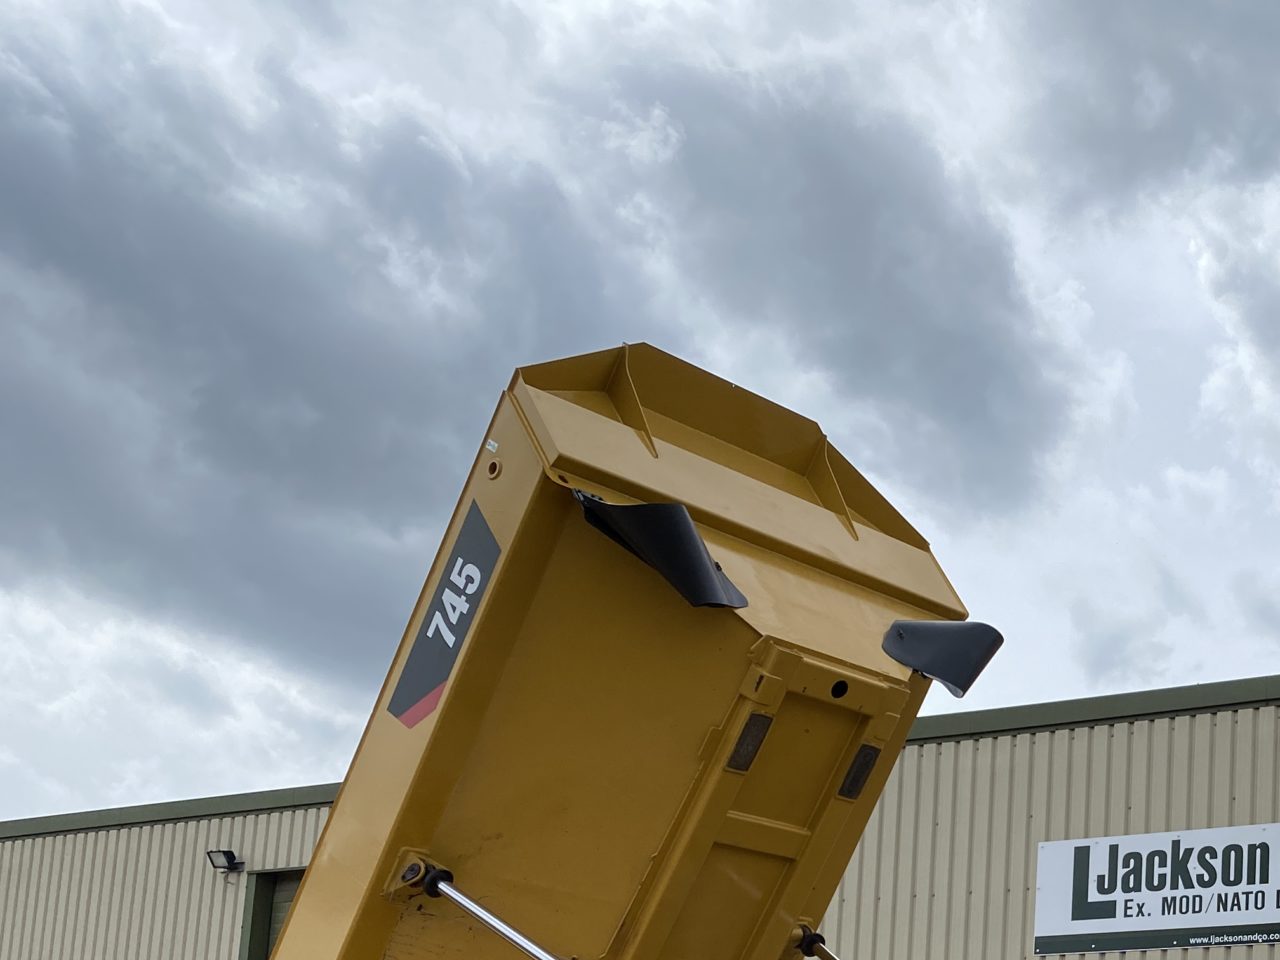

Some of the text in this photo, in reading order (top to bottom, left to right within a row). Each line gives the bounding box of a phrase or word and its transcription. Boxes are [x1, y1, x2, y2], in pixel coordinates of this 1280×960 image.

[426, 557, 481, 648] 745
[1124, 899, 1151, 918] Ex.
[1161, 890, 1266, 916] MOD/NATO
